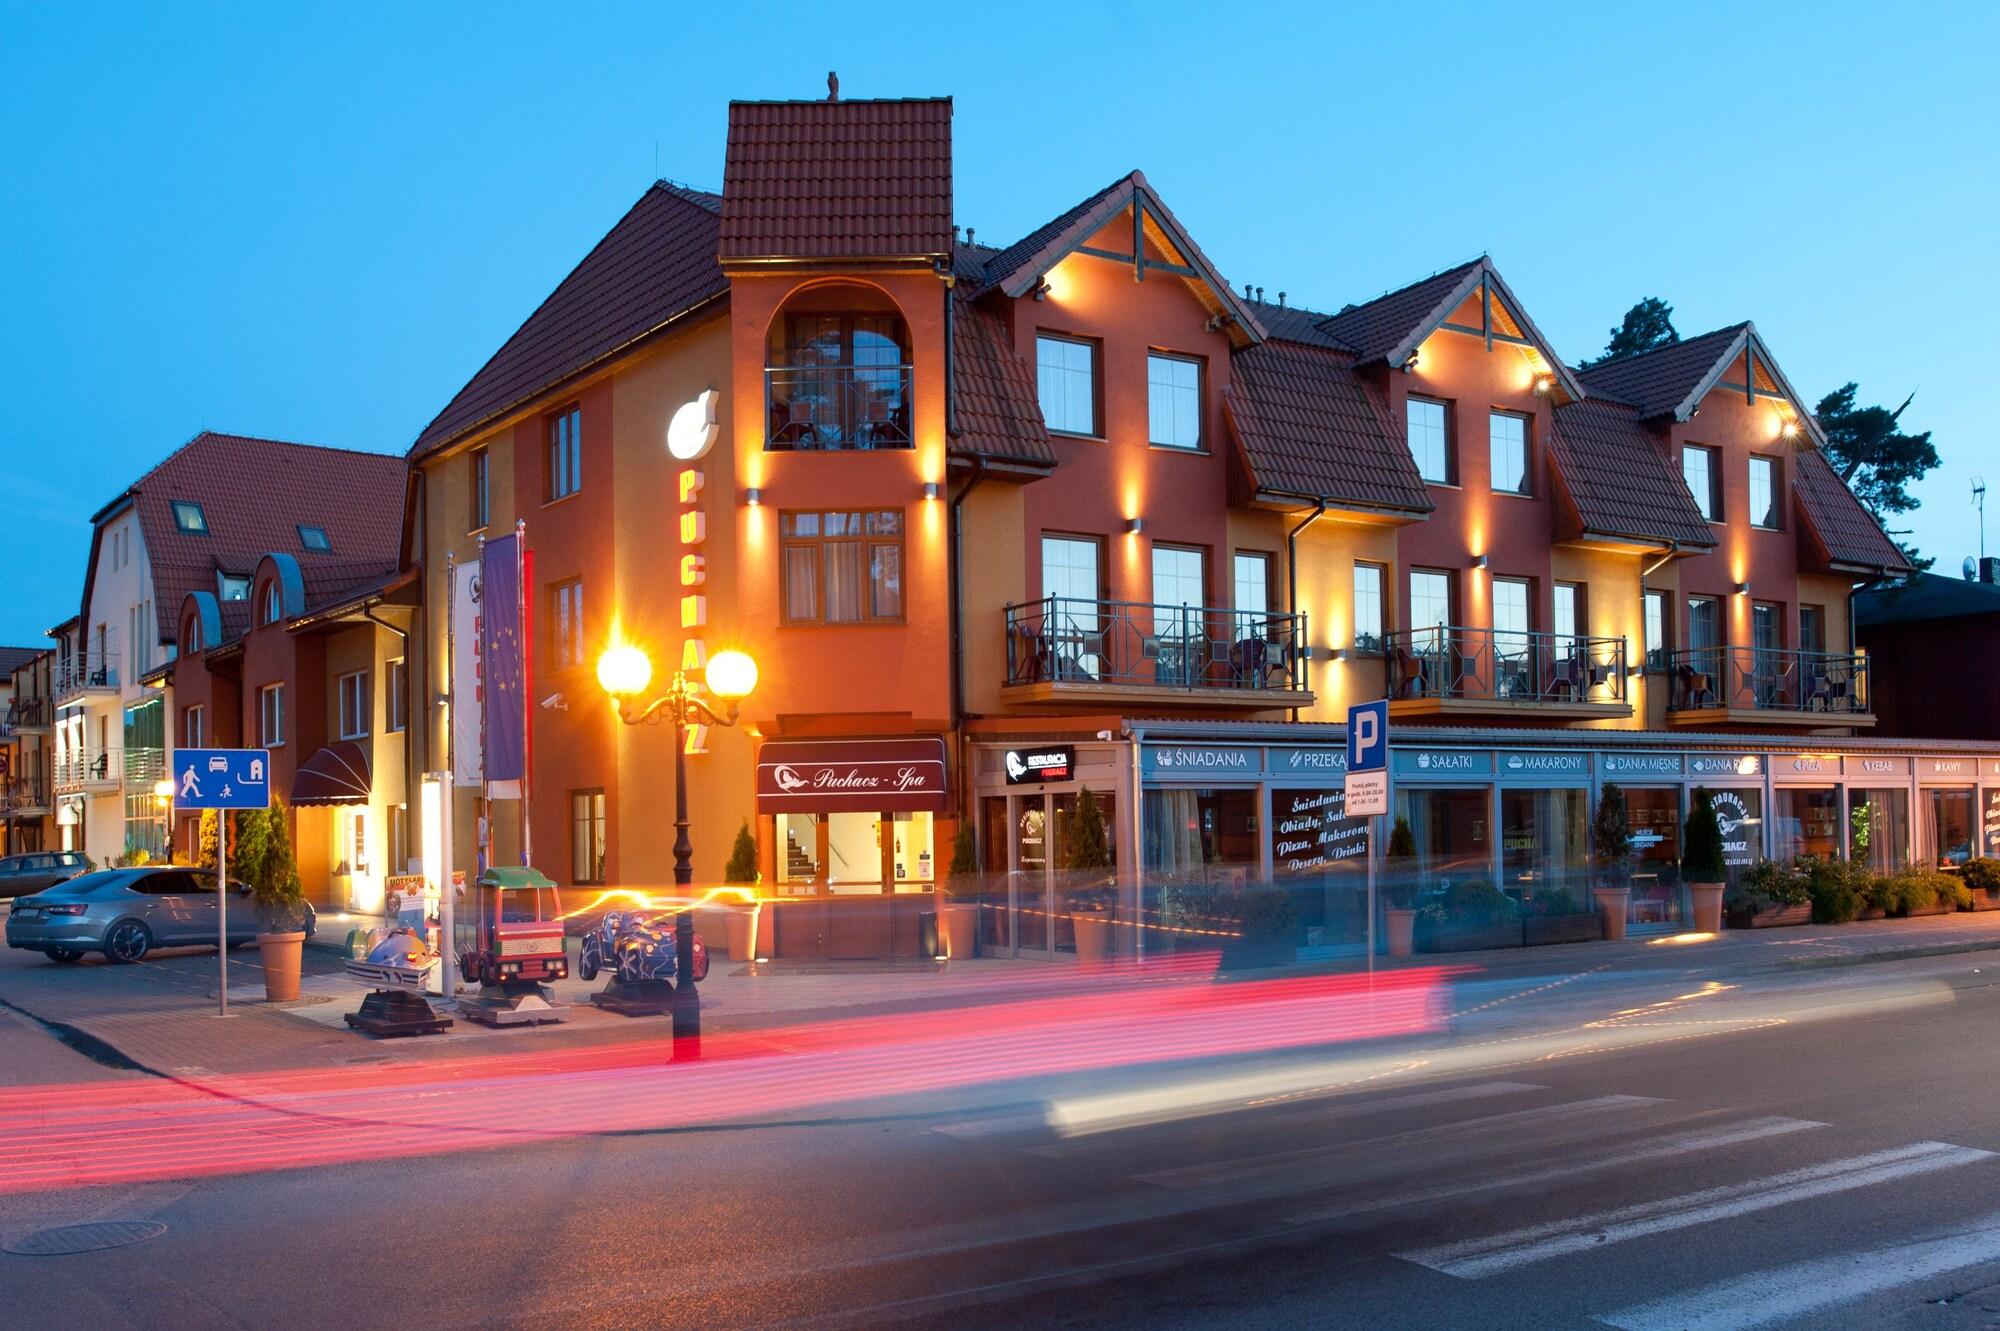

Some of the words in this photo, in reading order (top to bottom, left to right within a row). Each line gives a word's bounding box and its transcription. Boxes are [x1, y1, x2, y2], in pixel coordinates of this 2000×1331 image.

[1356, 710, 1378, 764] P
[1175, 748, 1247, 767] ŚNIADANIA
[1304, 753, 1348, 770] PRZEKĄ
[1432, 755, 1472, 769] SAŁATKI
[1525, 756, 1581, 769] MAKARONY
[1617, 758, 1647, 770] DANIA
[1705, 758, 1732, 770] DANIA
[1871, 761, 1893, 771] KEBAB
[1942, 761, 1960, 772] KAWY
[813, 768, 879, 789] Puchacz
[893, 767, 925, 791] Spa
[1710, 792, 1750, 821] STAURACJA
[1280, 816, 1321, 834] Obiady,
[1277, 841, 1311, 856] Pizza,
[1721, 841, 1748, 852] HACZ
[1287, 856, 1327, 871] Desery,
[1331, 841, 1366, 859] Drinki
